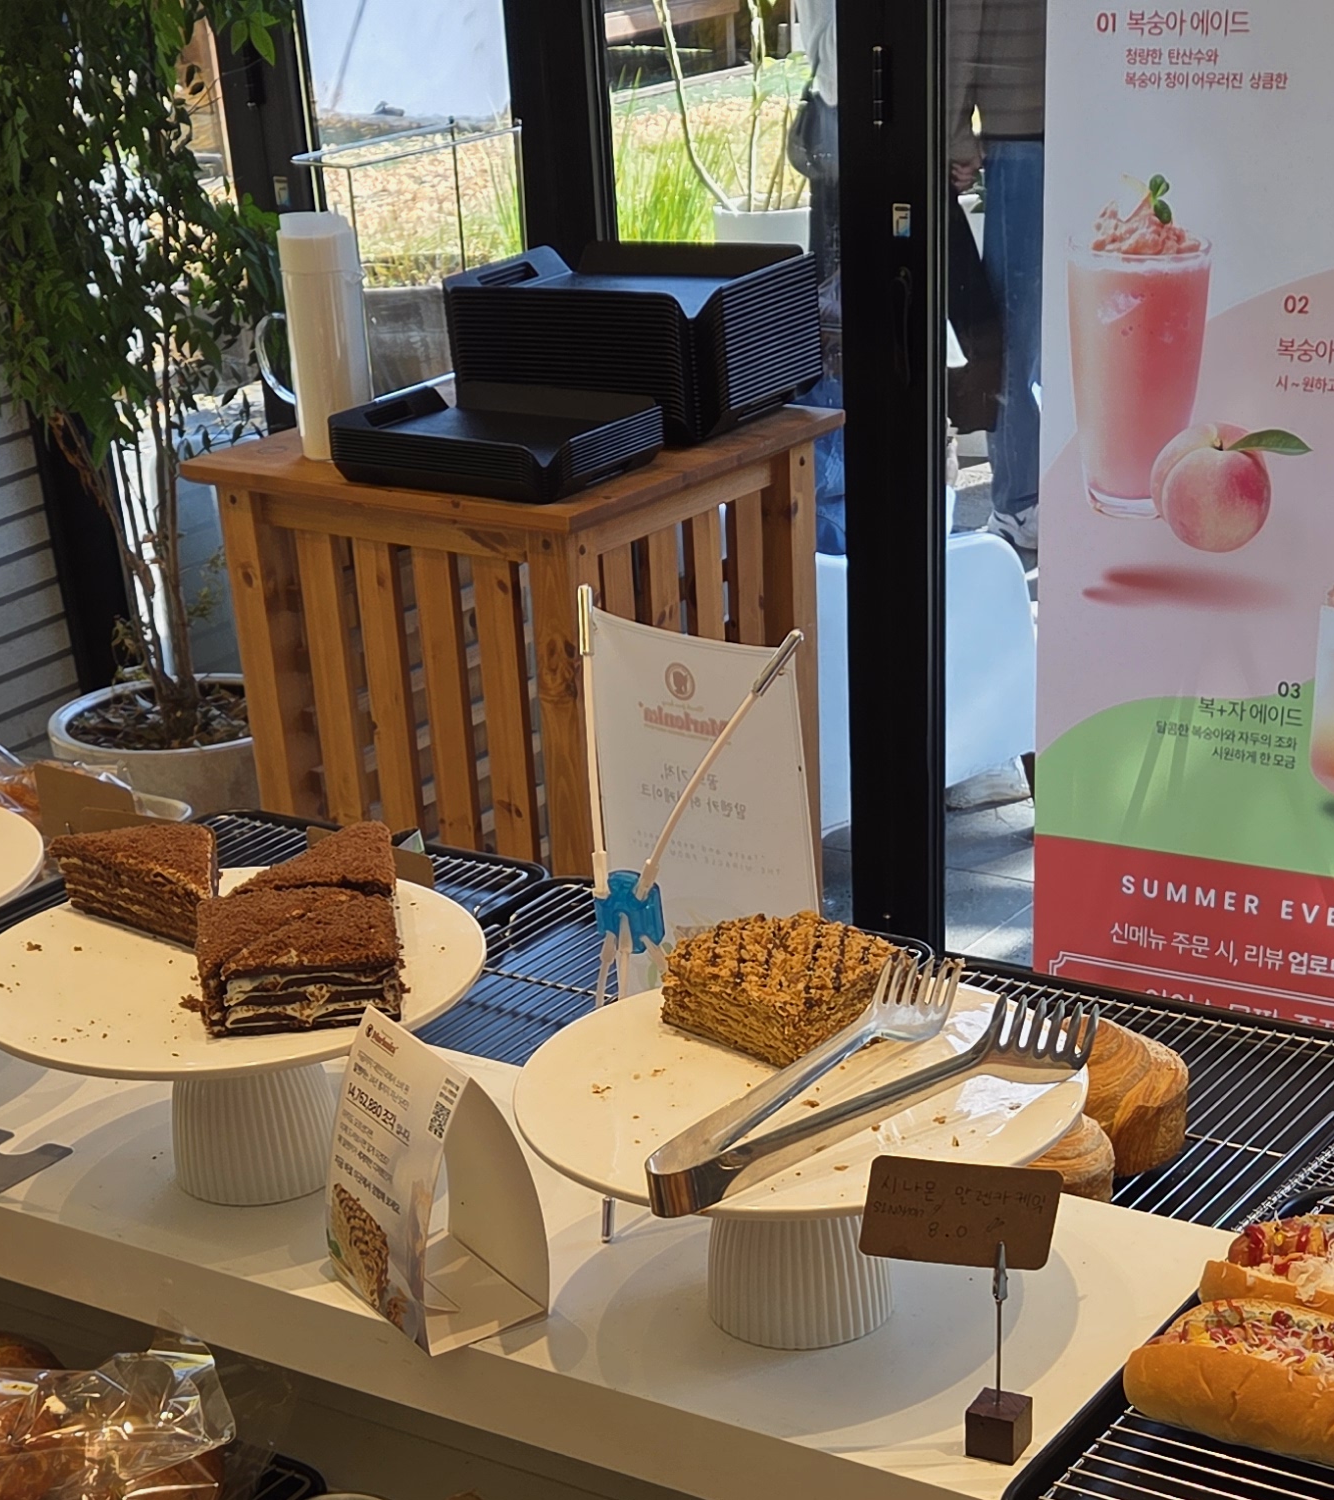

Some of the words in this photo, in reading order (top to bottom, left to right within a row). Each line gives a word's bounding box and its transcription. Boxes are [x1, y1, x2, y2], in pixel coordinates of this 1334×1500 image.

[1096, 12, 1116, 33] 01
[1127, 9, 1187, 37] 복숭아
[1190, 9, 1250, 37] 에이드
[1126, 48, 1163, 65] 청량한
[1167, 48, 1219, 66] 탄산수와
[1125, 71, 1162, 89] 복숭아
[1192, 71, 1243, 90] 어우러진
[1249, 72, 1288, 90] 상큼한
[1284, 295, 1309, 314] 02
[1278, 681, 1301, 699] 03
[1198, 697, 1246, 722] 복+자
[1249, 703, 1303, 727] 에이드
[1191, 725, 1236, 743] 복숭아와
[1237, 731, 1272, 748] 자두의
[1211, 746, 1257, 764] 시원하게
[1259, 751, 1271, 767] 한
[1273, 753, 1296, 770] 모금
[1121, 875, 1260, 915] SUMMER
[1110, 922, 1167, 951] 신메뉴
[1171, 931, 1210, 959] 주문
[1215, 940, 1239, 967] 시,
[1244, 944, 1284, 971] 리뷰
[880, 1175, 938, 1202] 시나몬
[927, 1221, 968, 1239] 8.0
